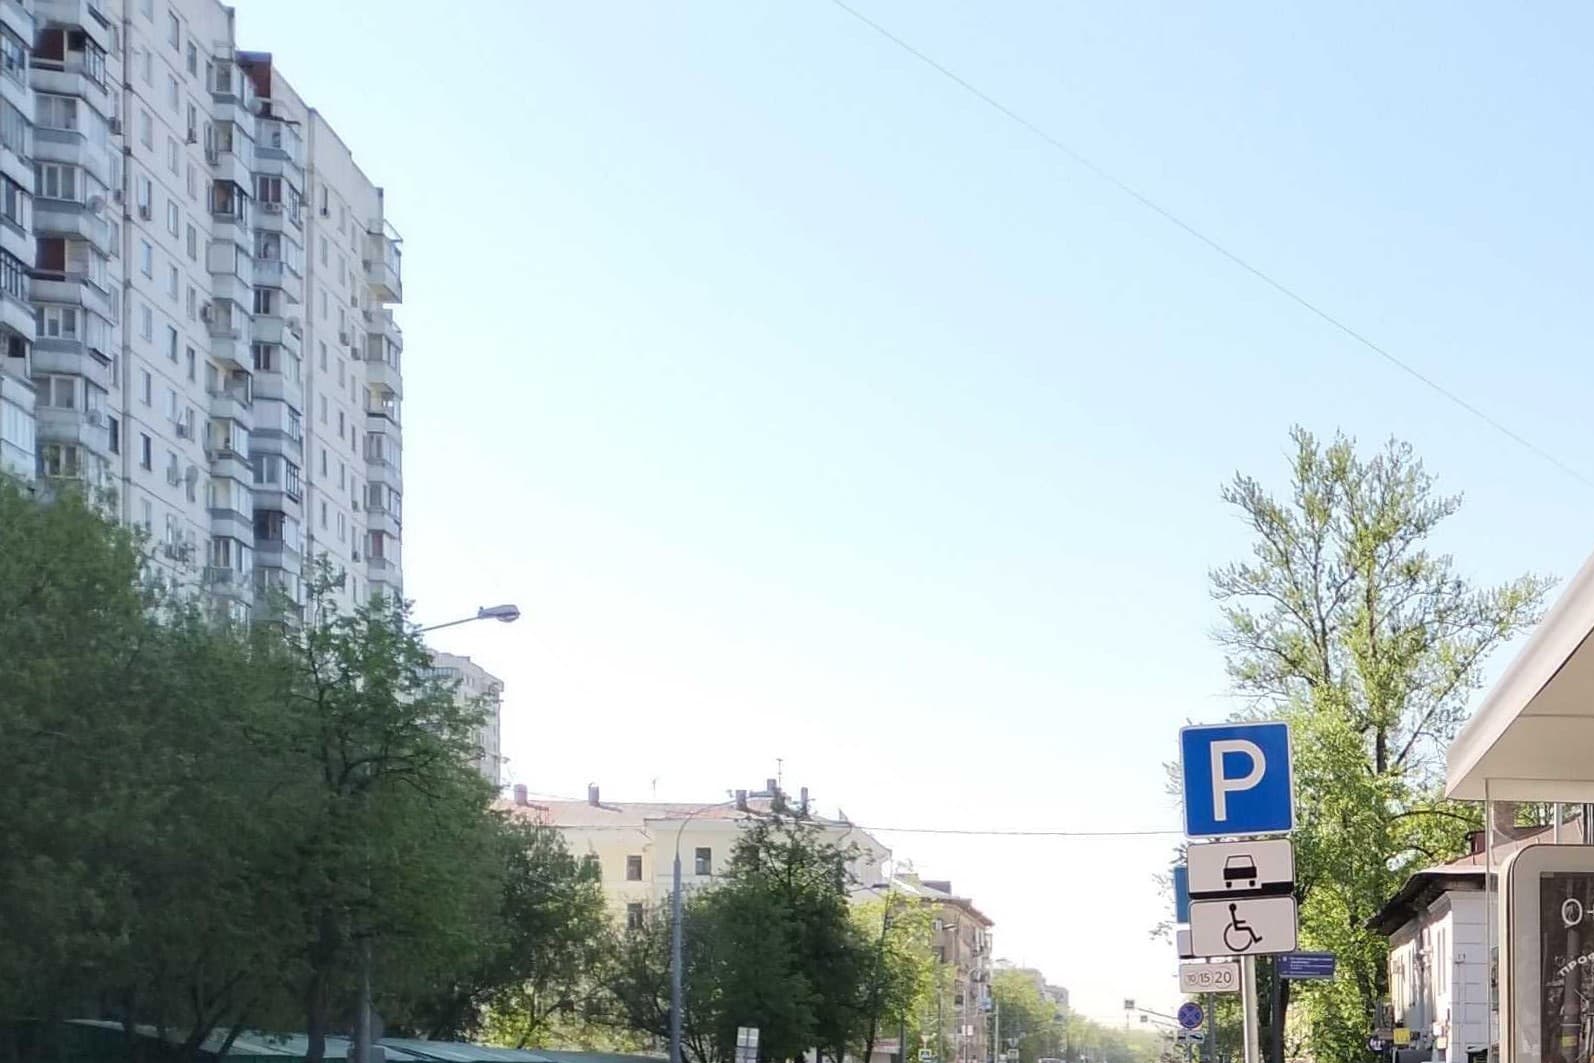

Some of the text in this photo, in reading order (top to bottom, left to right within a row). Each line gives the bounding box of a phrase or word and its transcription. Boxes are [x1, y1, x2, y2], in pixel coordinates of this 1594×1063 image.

[1209, 739, 1267, 822] P
[1200, 972, 1210, 983] 15
[1215, 971, 1232, 984] 20
